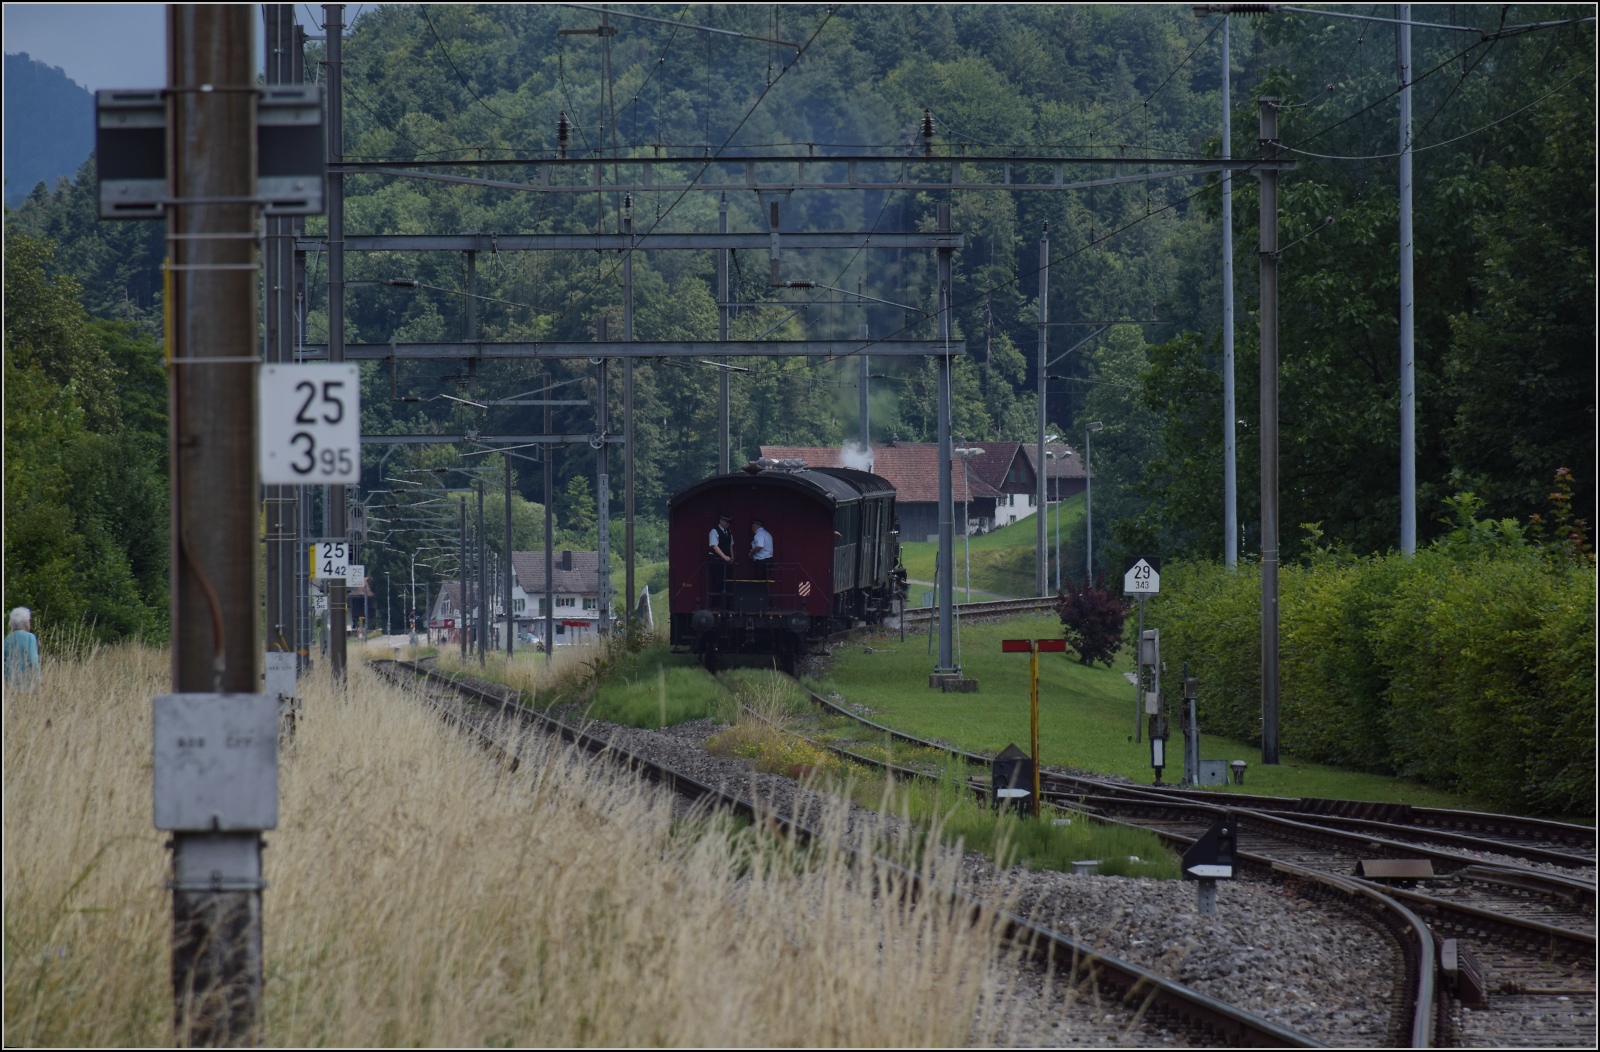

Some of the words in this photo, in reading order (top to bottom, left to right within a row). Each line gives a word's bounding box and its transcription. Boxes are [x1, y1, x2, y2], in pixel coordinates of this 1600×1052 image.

[295, 381, 345, 425] 25
[290, 432, 353, 475] 395
[323, 543, 344, 558] 25
[324, 560, 346, 576] 442
[352, 568, 362, 576] 25
[1135, 566, 1150, 579] 29
[1136, 581, 1149, 589] 343
